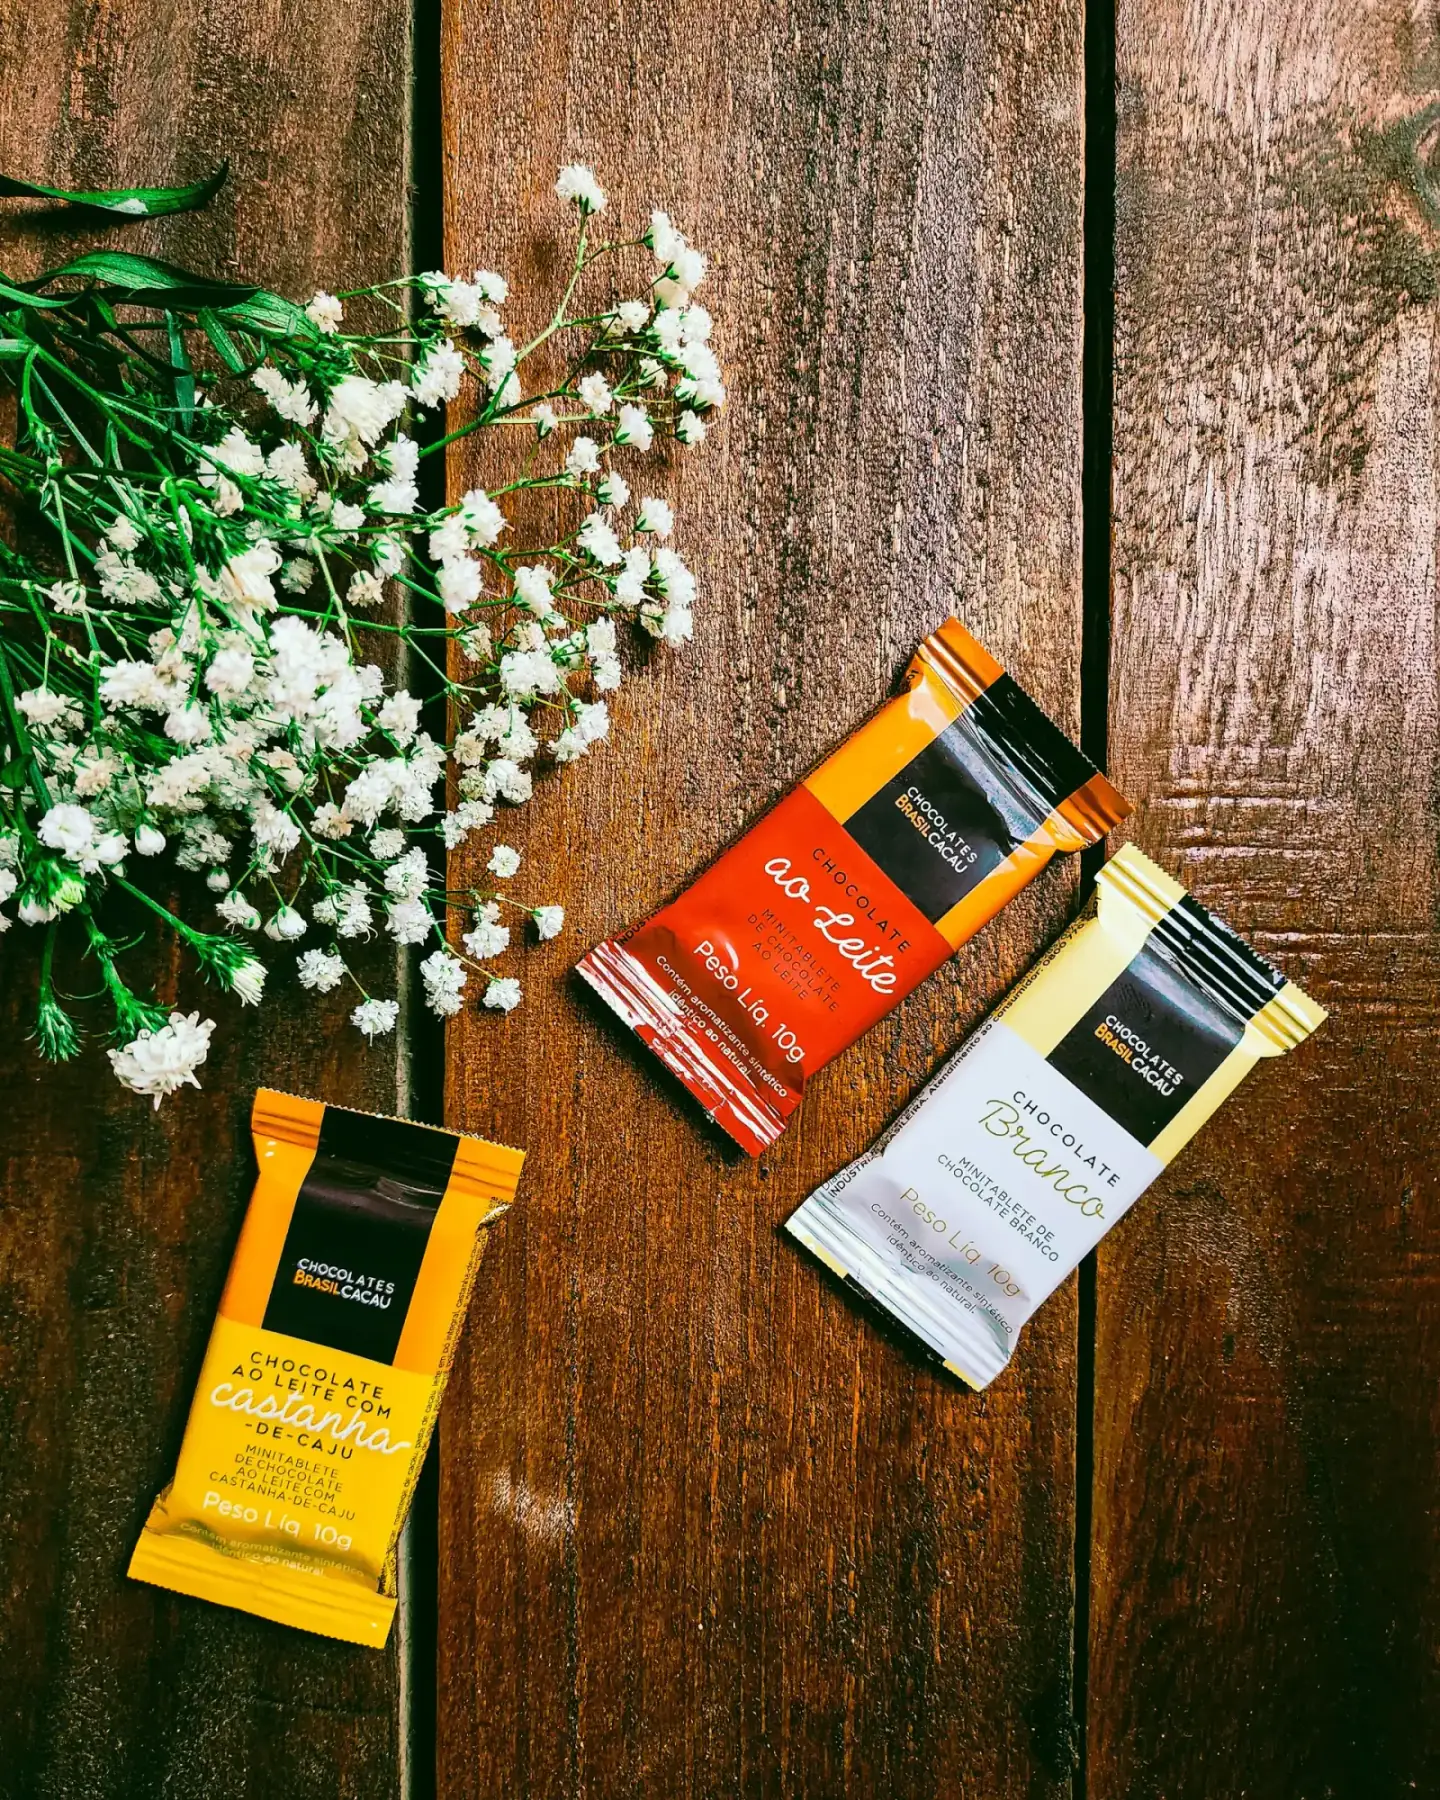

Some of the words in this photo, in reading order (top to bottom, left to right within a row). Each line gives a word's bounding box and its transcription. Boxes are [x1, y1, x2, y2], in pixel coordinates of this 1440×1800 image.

[904, 784, 979, 864] CHOCOLATES
[763, 856, 811, 904] ao
[812, 905, 897, 994] Leite
[810, 845, 911, 954] CHOCOLATE
[746, 913, 766, 934] DE
[765, 933, 839, 1012] CHOCOLATE
[750, 939, 773, 962] AO
[772, 962, 809, 1001] LEITE
[759, 907, 841, 993] MINITABLETE
[979, 1022, 993, 1036] ao
[1040, 939, 1067, 968] 0800
[654, 953, 694, 996] Contém
[688, 992, 752, 1057] aromatizante
[747, 1054, 790, 1100] sintético
[692, 938, 744, 993] Peso
[735, 985, 777, 1030] Líq.
[769, 1021, 810, 1067] 10g
[704, 1026, 720, 1043] ao
[1102, 1012, 1185, 1087] CHOCOLATES
[977, 1098, 1105, 1220] Branco
[1010, 1088, 1122, 1188] CHOCOLATE
[935, 1152, 1010, 1219] CHOCOLATE
[1008, 1215, 1060, 1263] BRANCO
[957, 1155, 1037, 1227] MINITABLETE
[1035, 1223, 1055, 1243] DE
[296, 1256, 396, 1295] CHOCOLATES
[869, 1200, 911, 1240] Contém
[907, 1237, 974, 1293] aromatizante
[971, 1288, 1015, 1335] sintético
[885, 1232, 927, 1273] idêntico
[924, 1267, 941, 1283] ao
[938, 1278, 979, 1315] natural.
[898, 1185, 951, 1235] Peso
[947, 1228, 988, 1269] Líq.
[985, 1261, 1025, 1301] 10g
[231, 1361, 264, 1382] AO
[274, 1373, 335, 1402] LEITE
[344, 1394, 392, 1419] COM
[249, 1349, 384, 1399] CHOCOLATE
[209, 1382, 412, 1455] castanha
[243, 1417, 354, 1461] -DE-CAJU
[208, 1469, 356, 1521] CASTANHA-DE-CAJU
[233, 1452, 254, 1467] DE
[255, 1458, 344, 1493] CHOCOLATE
[235, 1465, 258, 1480] AO
[261, 1472, 301, 1492] LEITE
[302, 1484, 336, 1503] COM
[244, 1442, 339, 1479] MINITABLETE
[201, 1489, 260, 1525] Peso
[310, 1521, 354, 1552] 10g
